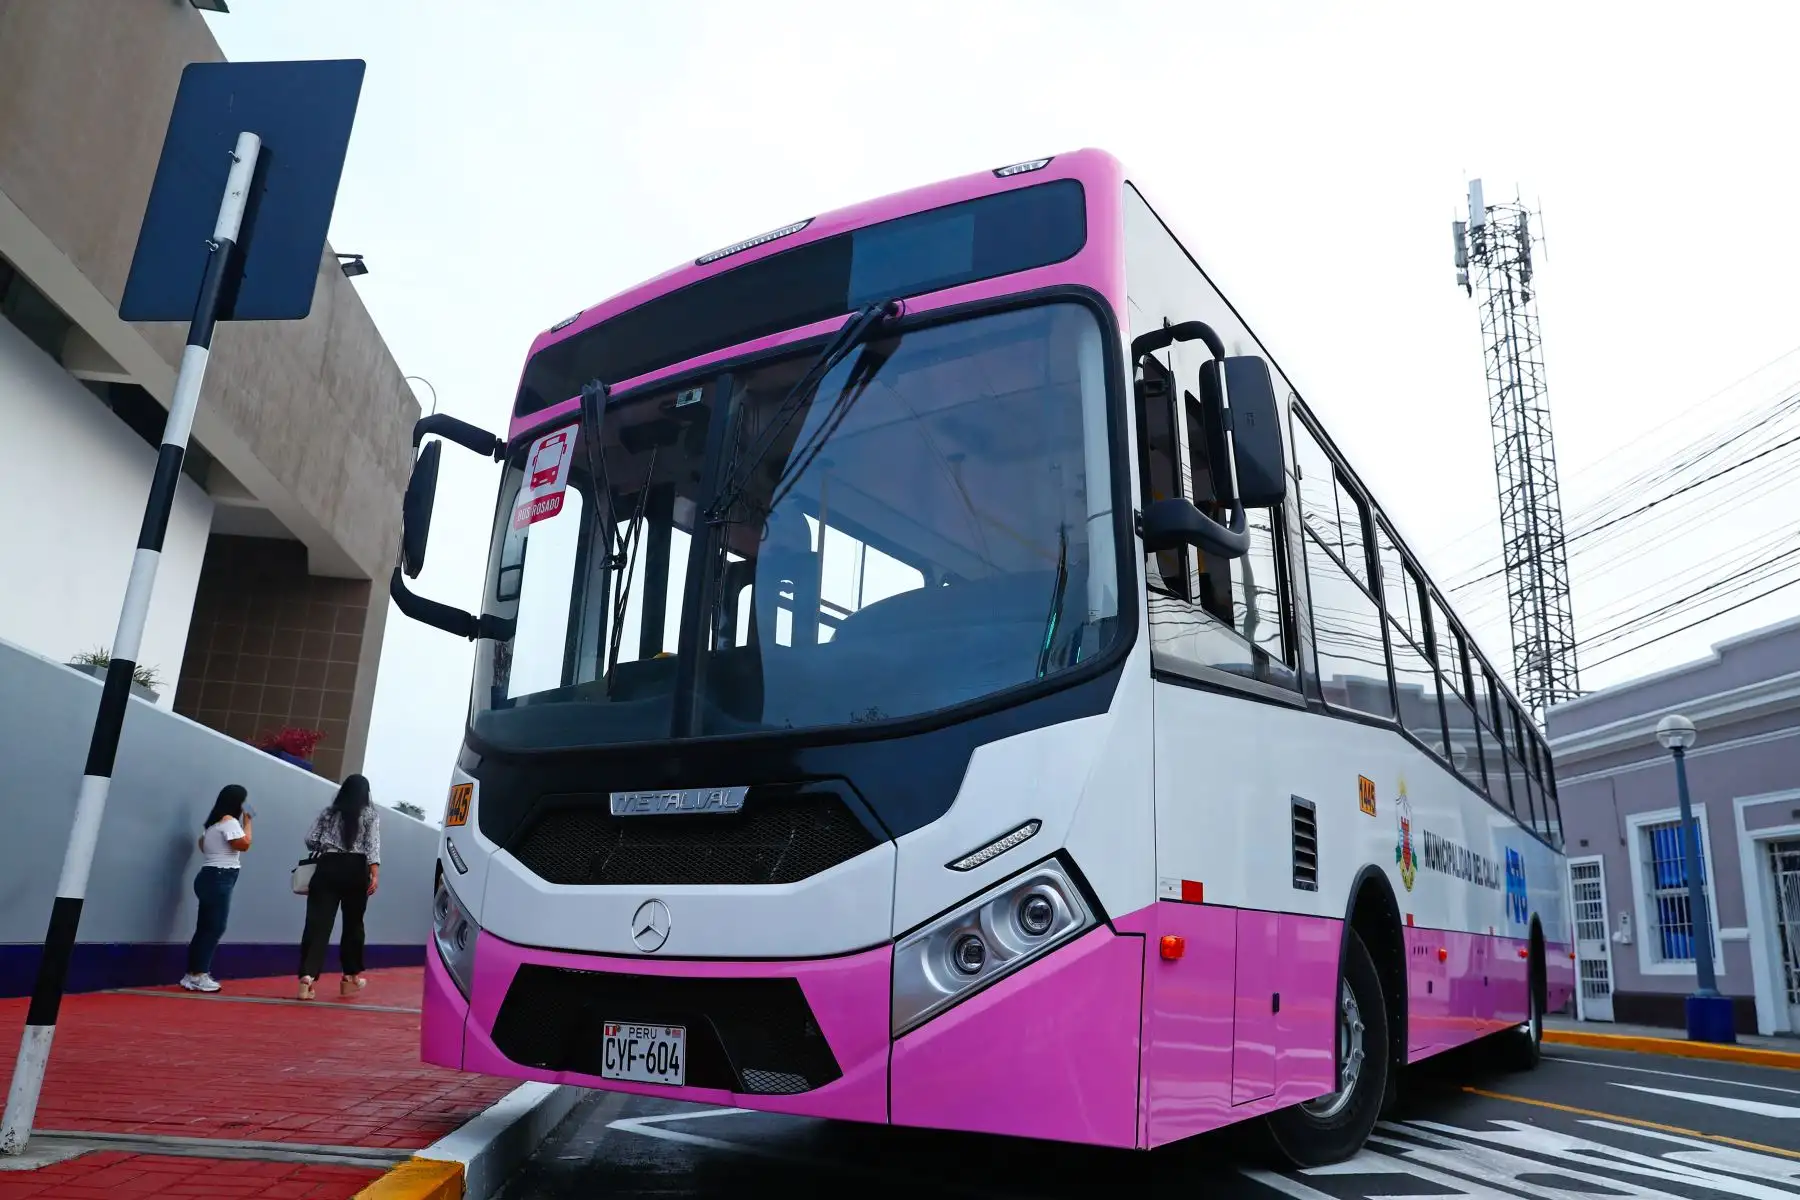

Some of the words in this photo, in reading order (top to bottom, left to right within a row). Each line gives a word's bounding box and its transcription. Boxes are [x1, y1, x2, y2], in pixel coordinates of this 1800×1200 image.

[531, 496, 560, 517] ROSADO
[1423, 829, 1472, 882] MUNICIPALIDAD
[1472, 852, 1483, 886] DEL
[628, 1026, 658, 1040] PERU
[605, 1037, 680, 1077] CYF-604
